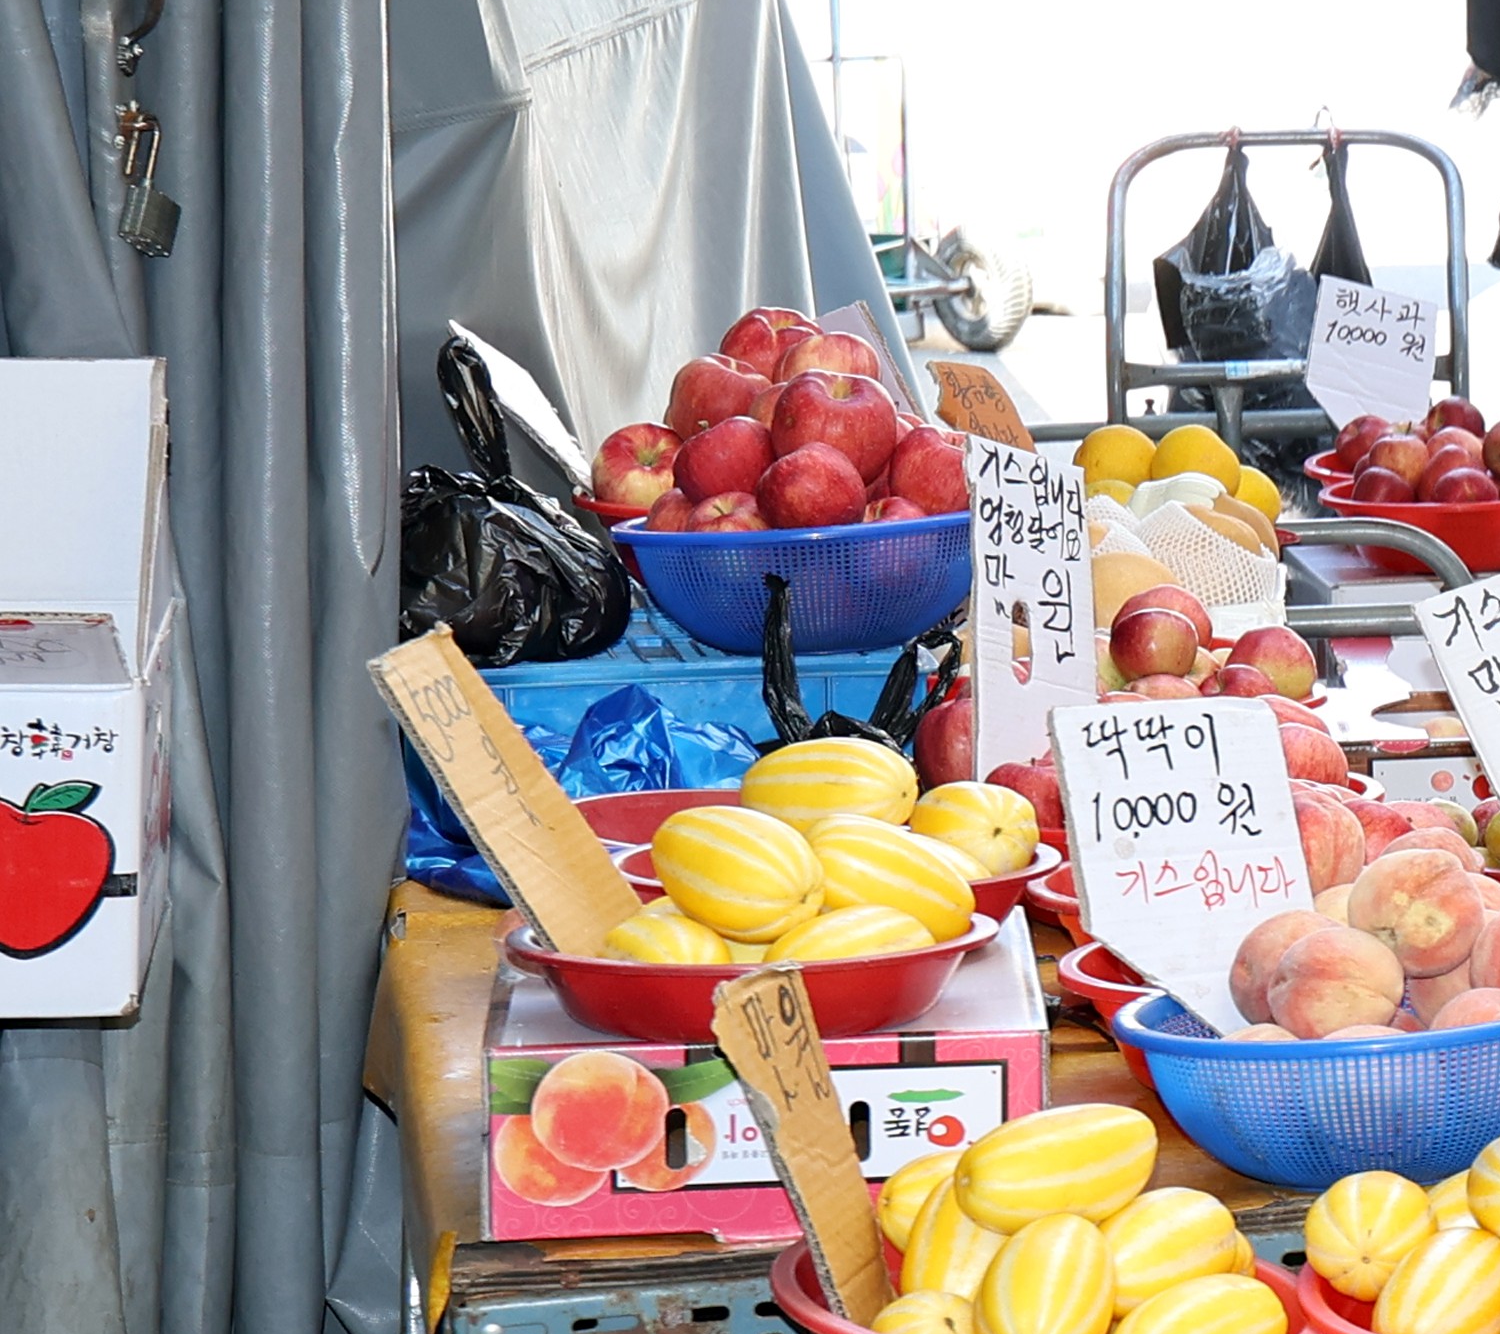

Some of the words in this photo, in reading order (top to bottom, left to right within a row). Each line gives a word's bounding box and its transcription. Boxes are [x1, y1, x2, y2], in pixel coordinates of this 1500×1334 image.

[1400, 331, 1427, 363] 원
[1037, 567, 1077, 665] 원
[1081, 709, 1223, 781] 딱딱이
[1216, 781, 1265, 838] 원
[1114, 850, 1298, 912] 기스입니다
